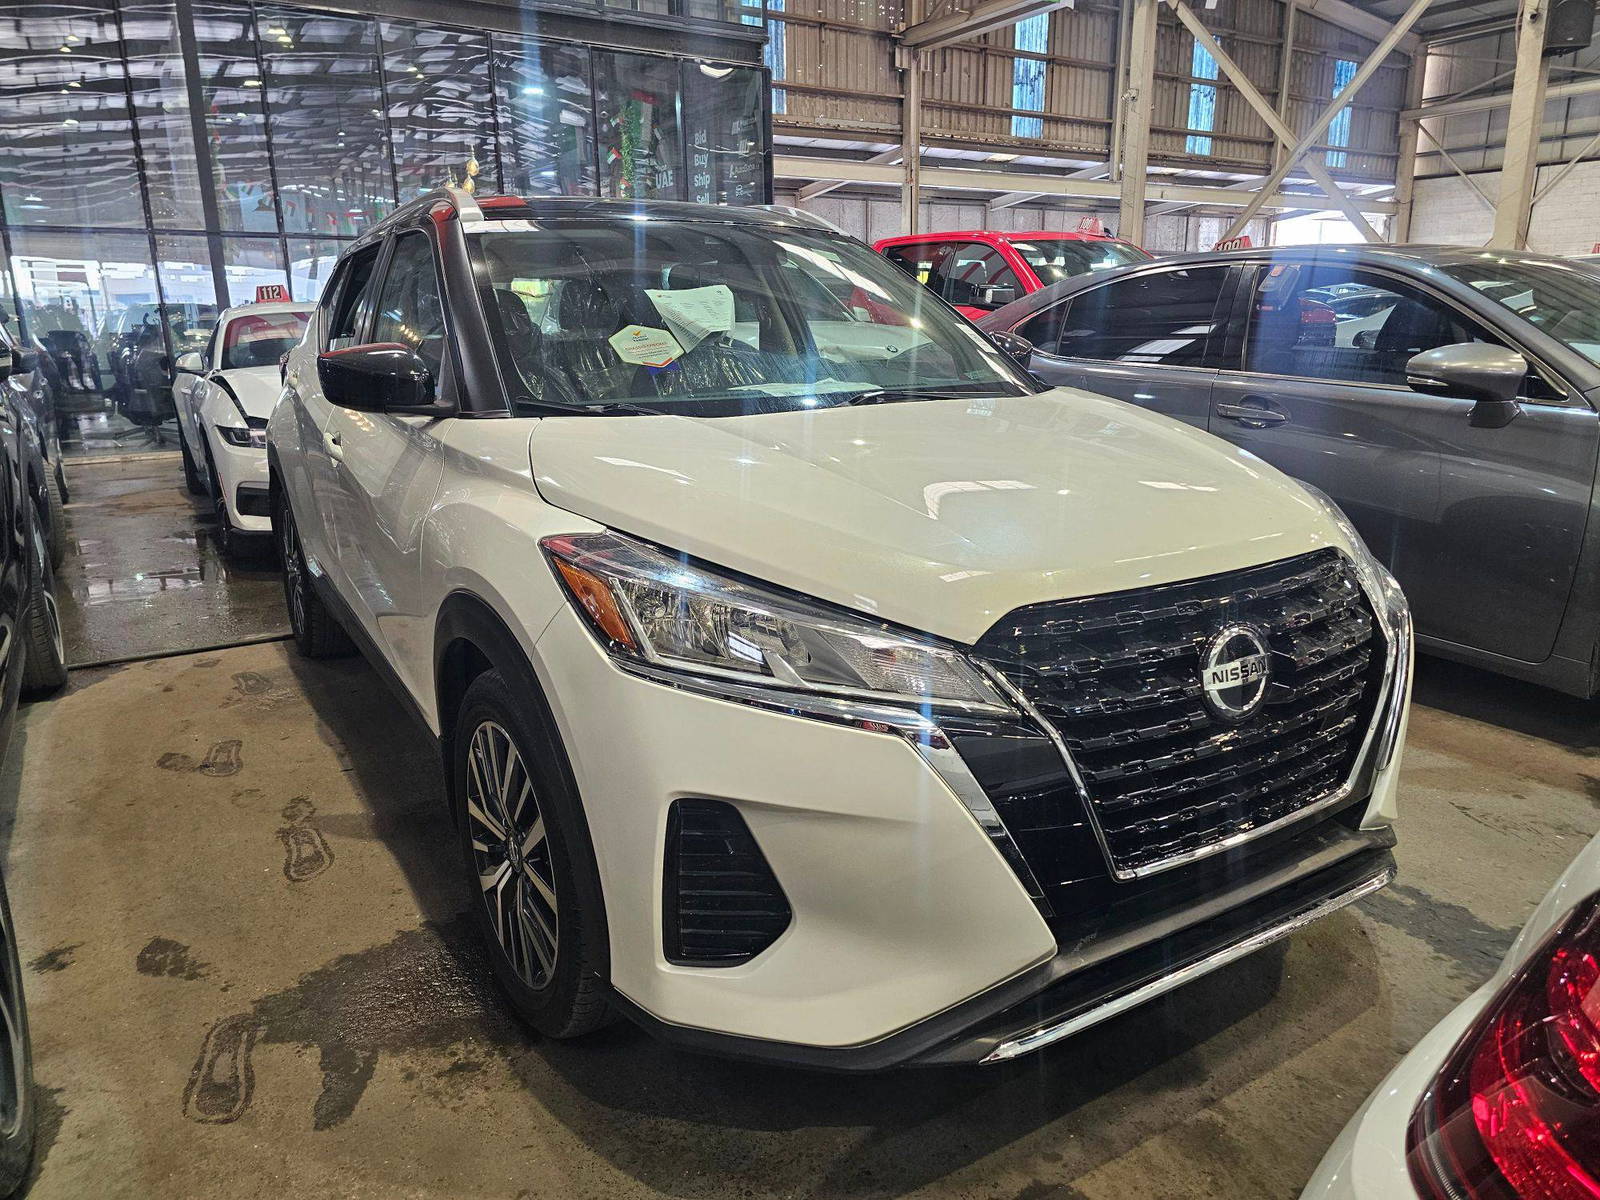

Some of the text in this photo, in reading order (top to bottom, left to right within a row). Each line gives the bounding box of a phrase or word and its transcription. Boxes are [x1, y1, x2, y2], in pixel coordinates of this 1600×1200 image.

[694, 130, 707, 146] Bid
[694, 154, 709, 168] Buy
[655, 170, 673, 189] UAE
[262, 286, 280, 299] 112
[1212, 660, 1266, 684] NISSAN
